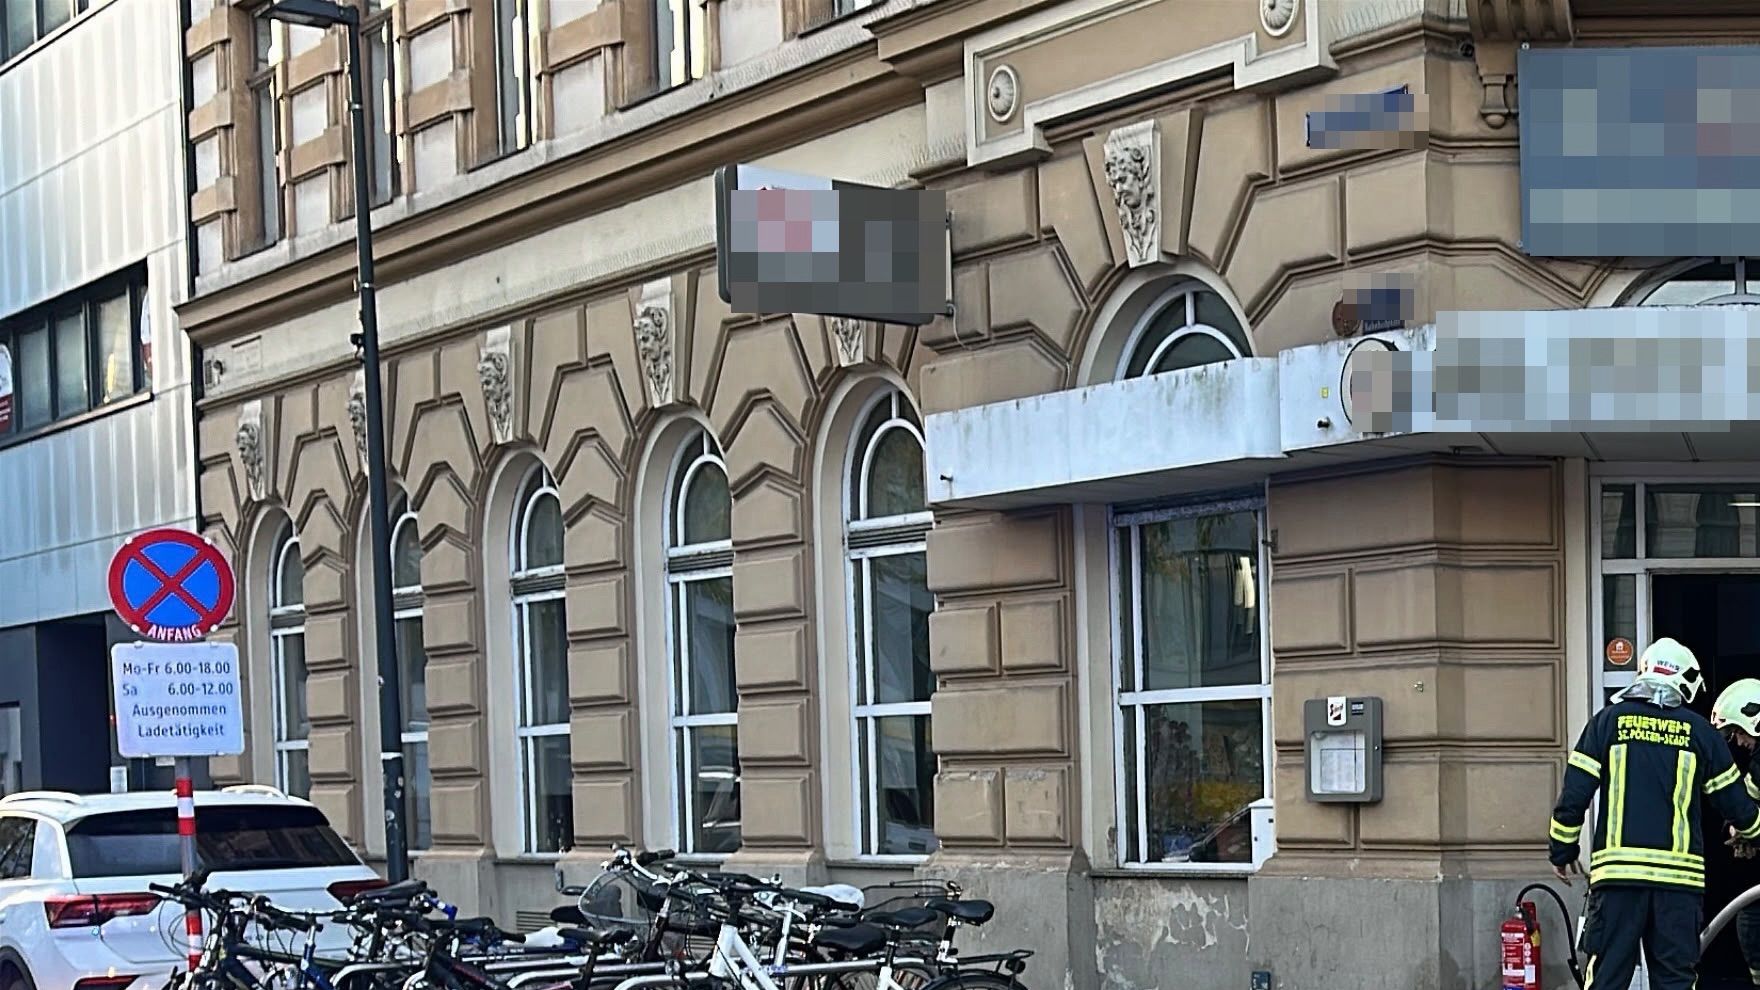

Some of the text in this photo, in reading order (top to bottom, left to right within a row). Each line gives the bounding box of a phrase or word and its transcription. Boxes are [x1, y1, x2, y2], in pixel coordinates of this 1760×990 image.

[147, 624, 201, 641] ANFANG
[123, 661, 231, 676] Mo-Fr 6.00-18.00
[122, 682, 234, 696] Sa 6.00-12.00
[132, 703, 227, 719] Ausgenommen
[138, 722, 225, 739] Ladetätigkeit
[1617, 715, 1691, 736] FEUERWEHR
